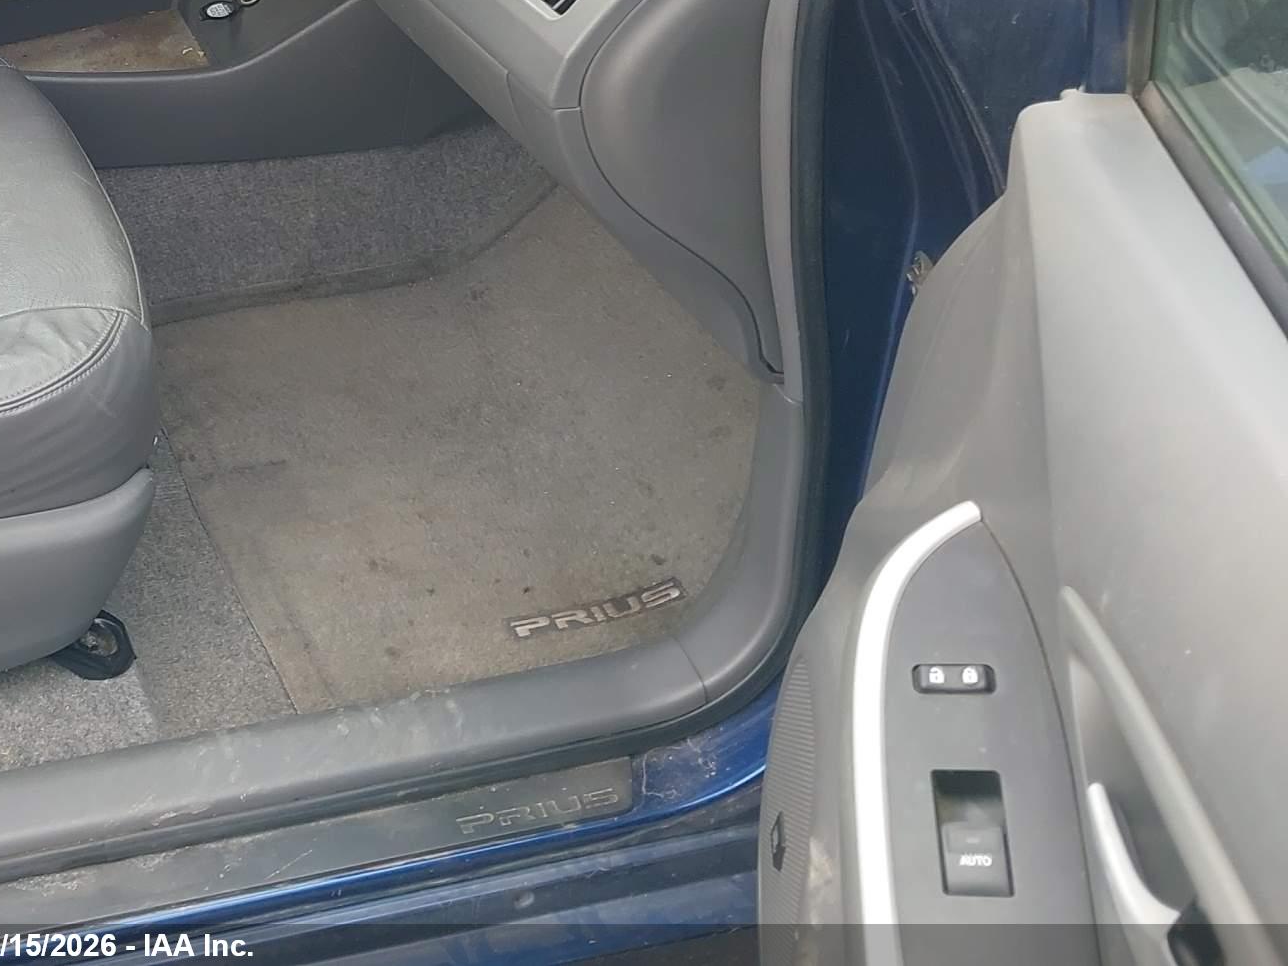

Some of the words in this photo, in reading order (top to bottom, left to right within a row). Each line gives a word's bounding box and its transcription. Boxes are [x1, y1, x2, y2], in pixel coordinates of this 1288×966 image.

[509, 581, 681, 638] PRIUS
[455, 787, 619, 835] PRIUS
[959, 854, 992, 866] AUTO
